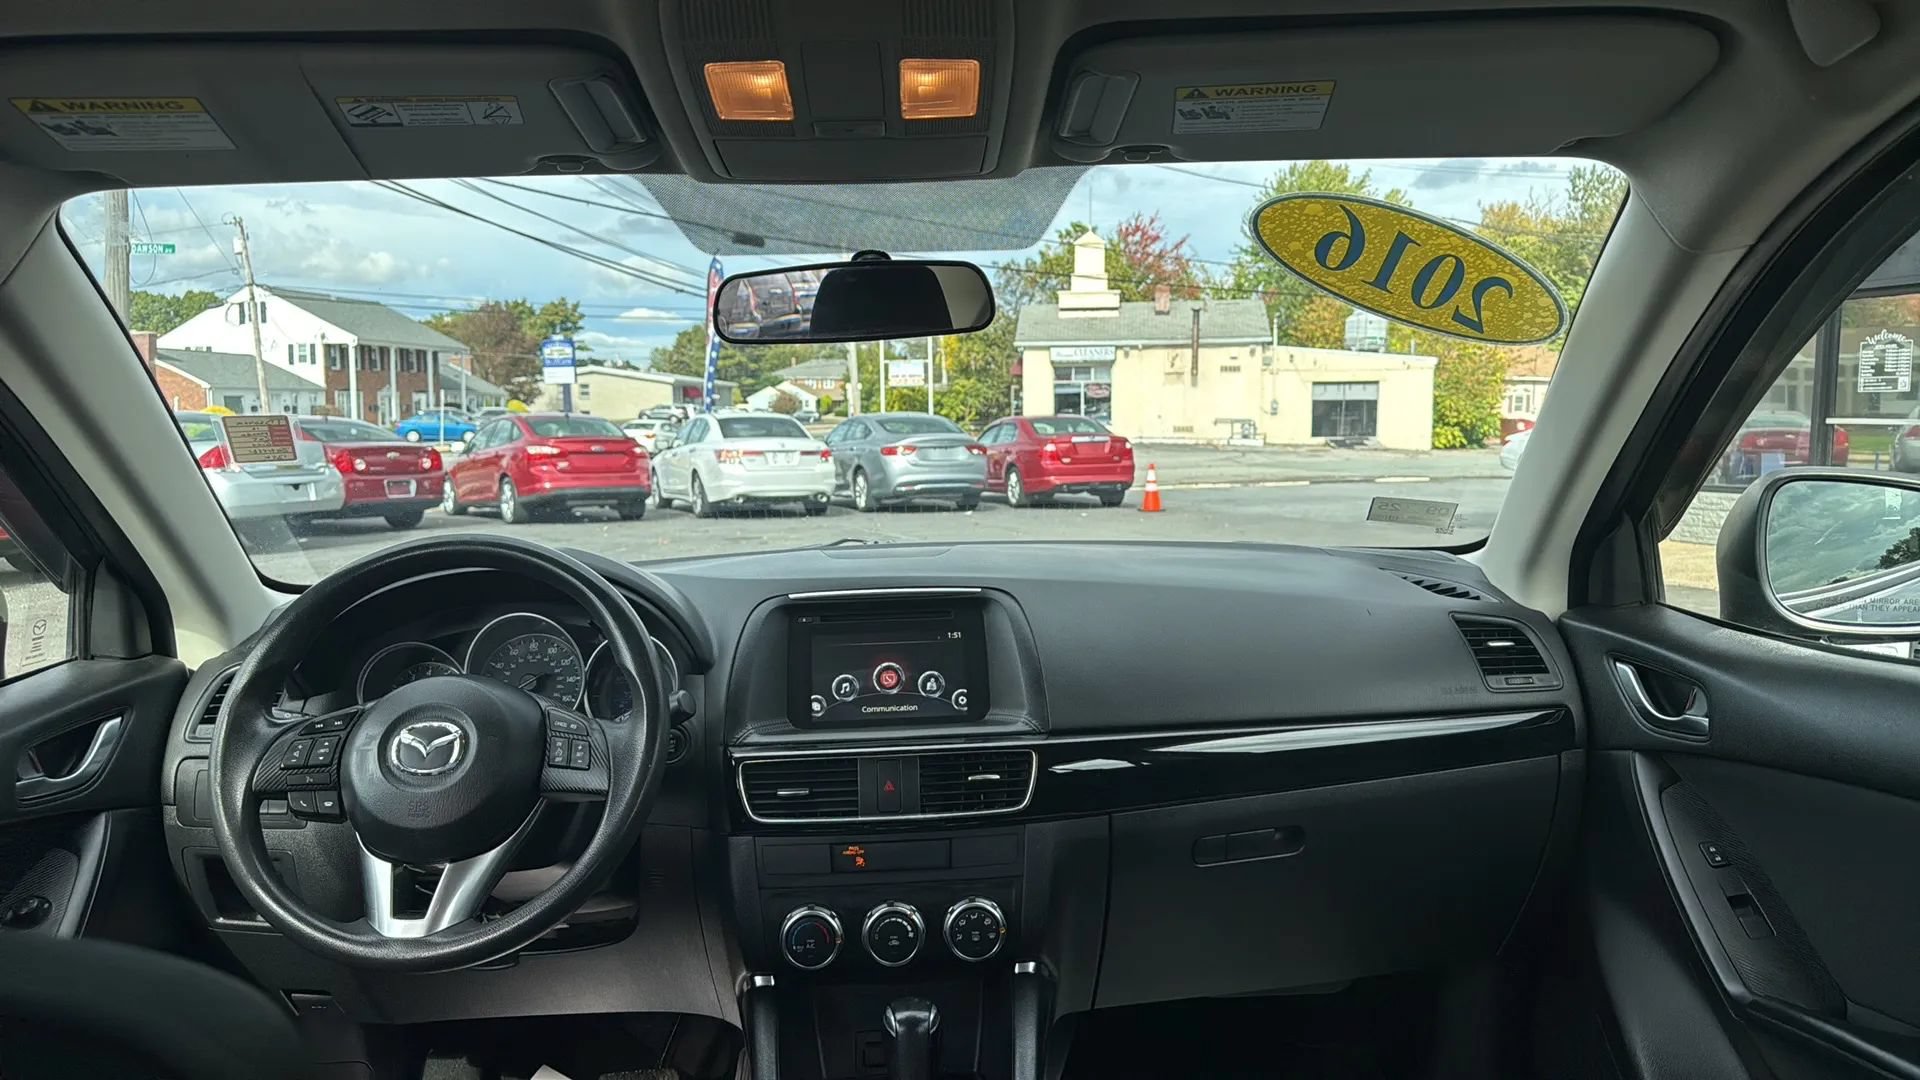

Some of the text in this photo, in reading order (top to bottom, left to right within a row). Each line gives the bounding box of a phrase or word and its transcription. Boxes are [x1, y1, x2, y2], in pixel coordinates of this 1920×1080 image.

[1215, 85, 1318, 97] WARNING
[61, 101, 185, 110] WARNING
[1866, 328, 1907, 345] Welcome
[1869, 597, 1900, 605] MIRROR
[1871, 604, 1890, 612] THEY
[861, 704, 919, 713] Communication
